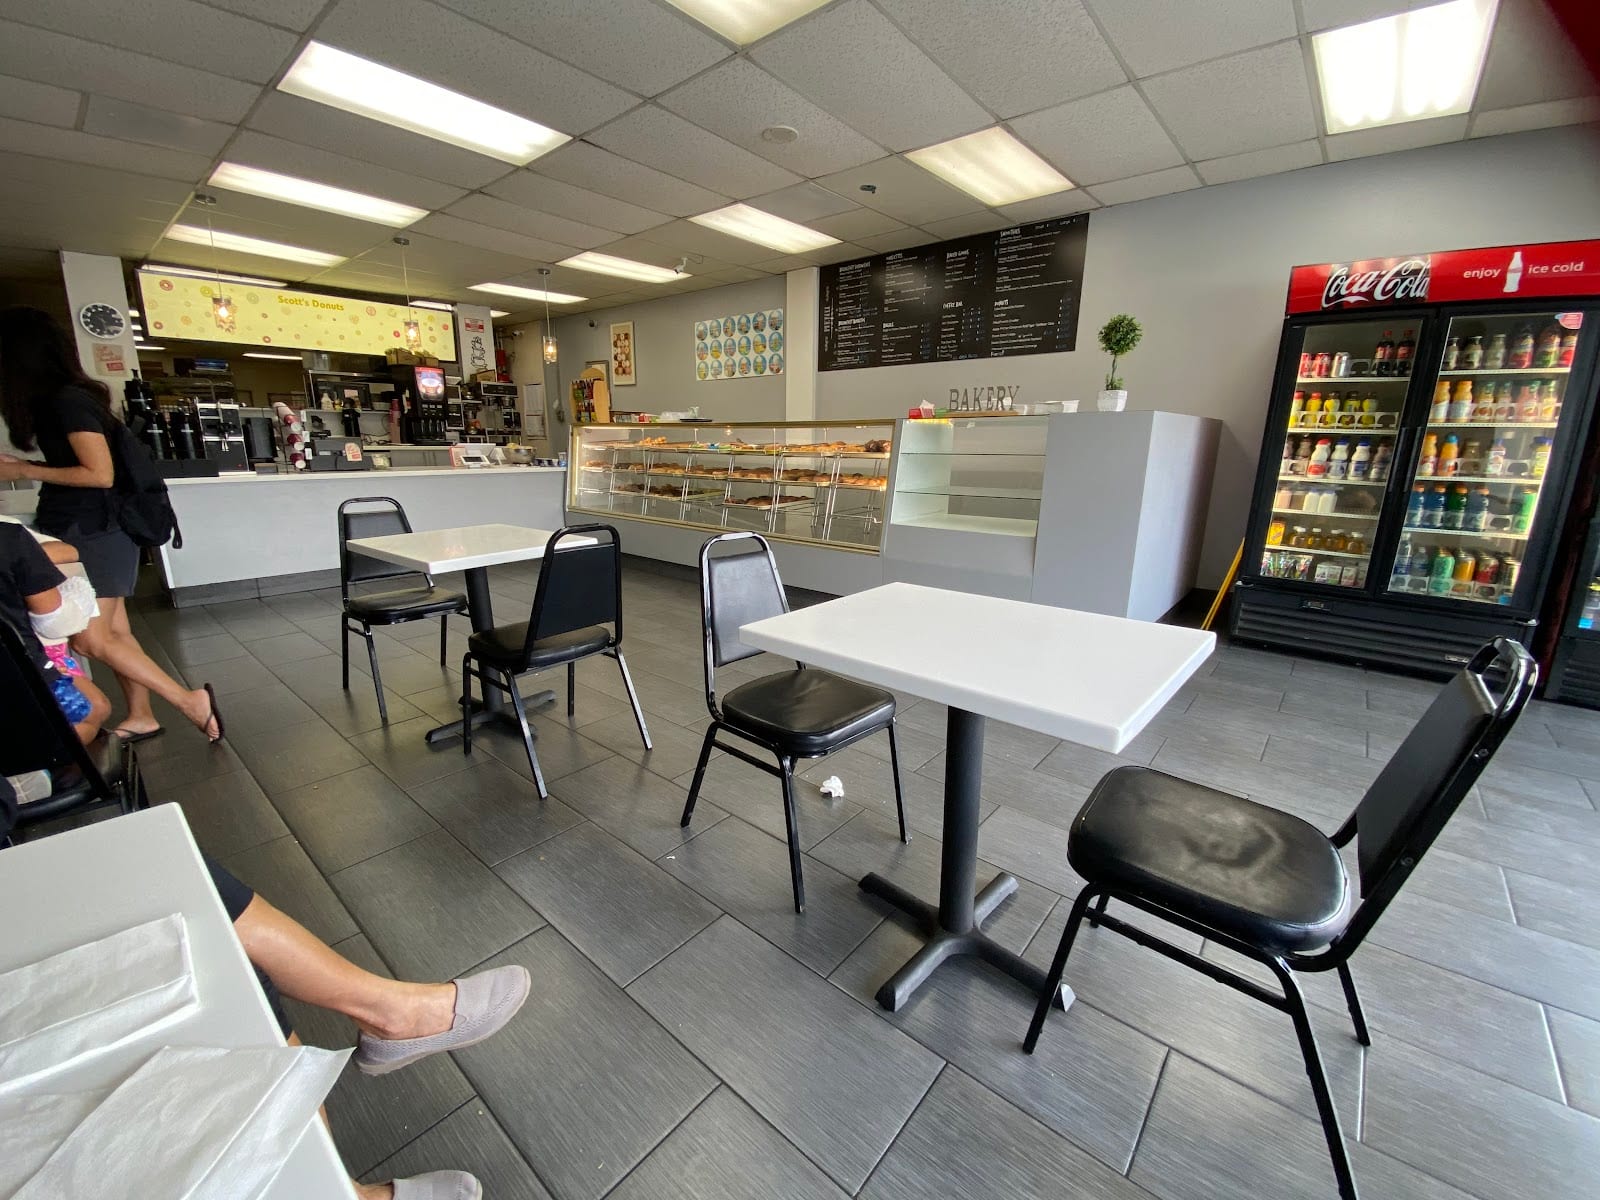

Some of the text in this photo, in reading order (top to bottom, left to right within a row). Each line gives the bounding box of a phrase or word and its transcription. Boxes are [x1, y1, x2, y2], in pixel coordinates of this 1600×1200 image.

[1463, 261, 1584, 279] enjoy ice cold
[1321, 259, 1431, 308] Coca-Cola
[277, 295, 344, 311] Scott's Donuts
[949, 385, 1019, 411] BAKERY
